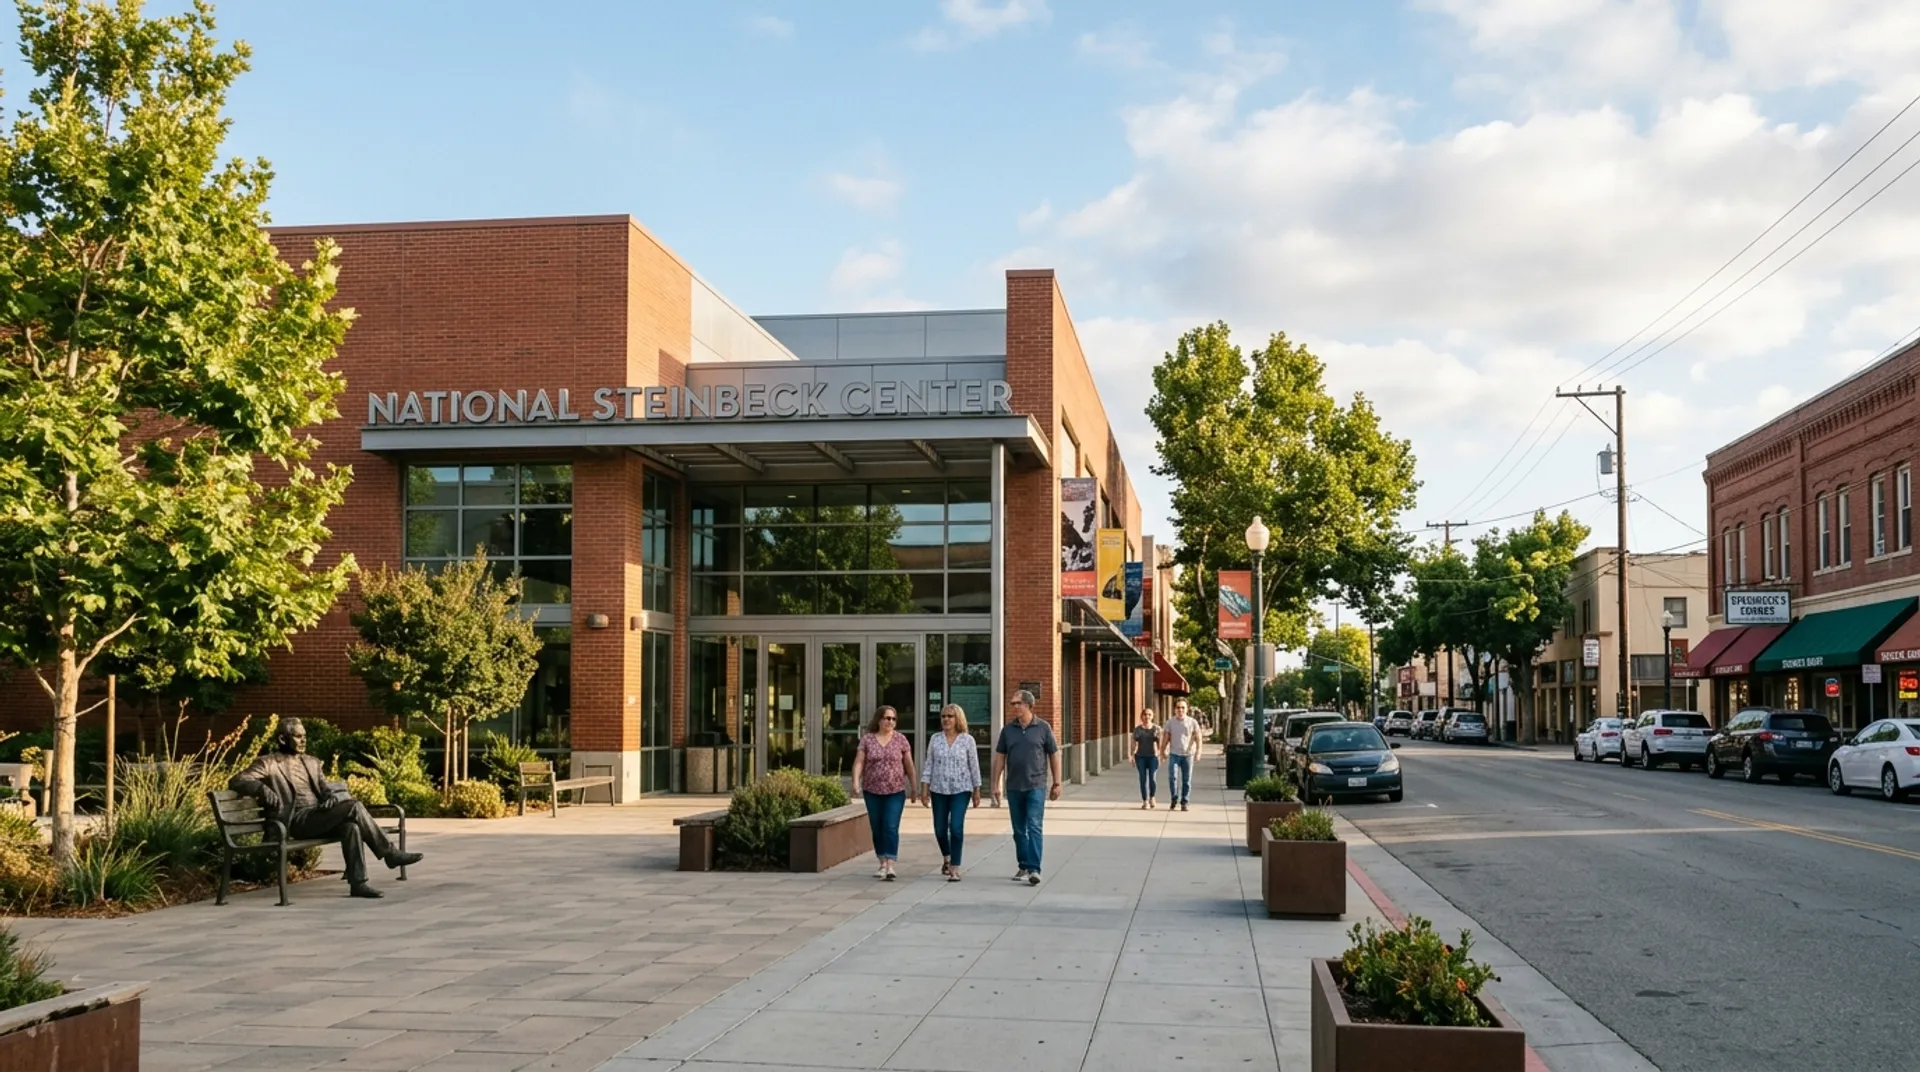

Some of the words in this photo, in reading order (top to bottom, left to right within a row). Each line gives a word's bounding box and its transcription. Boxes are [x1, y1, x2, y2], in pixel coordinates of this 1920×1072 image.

[368, 388, 580, 425] NATIONAL
[592, 382, 829, 421] STEINBECK
[840, 379, 1013, 416] CENTER
